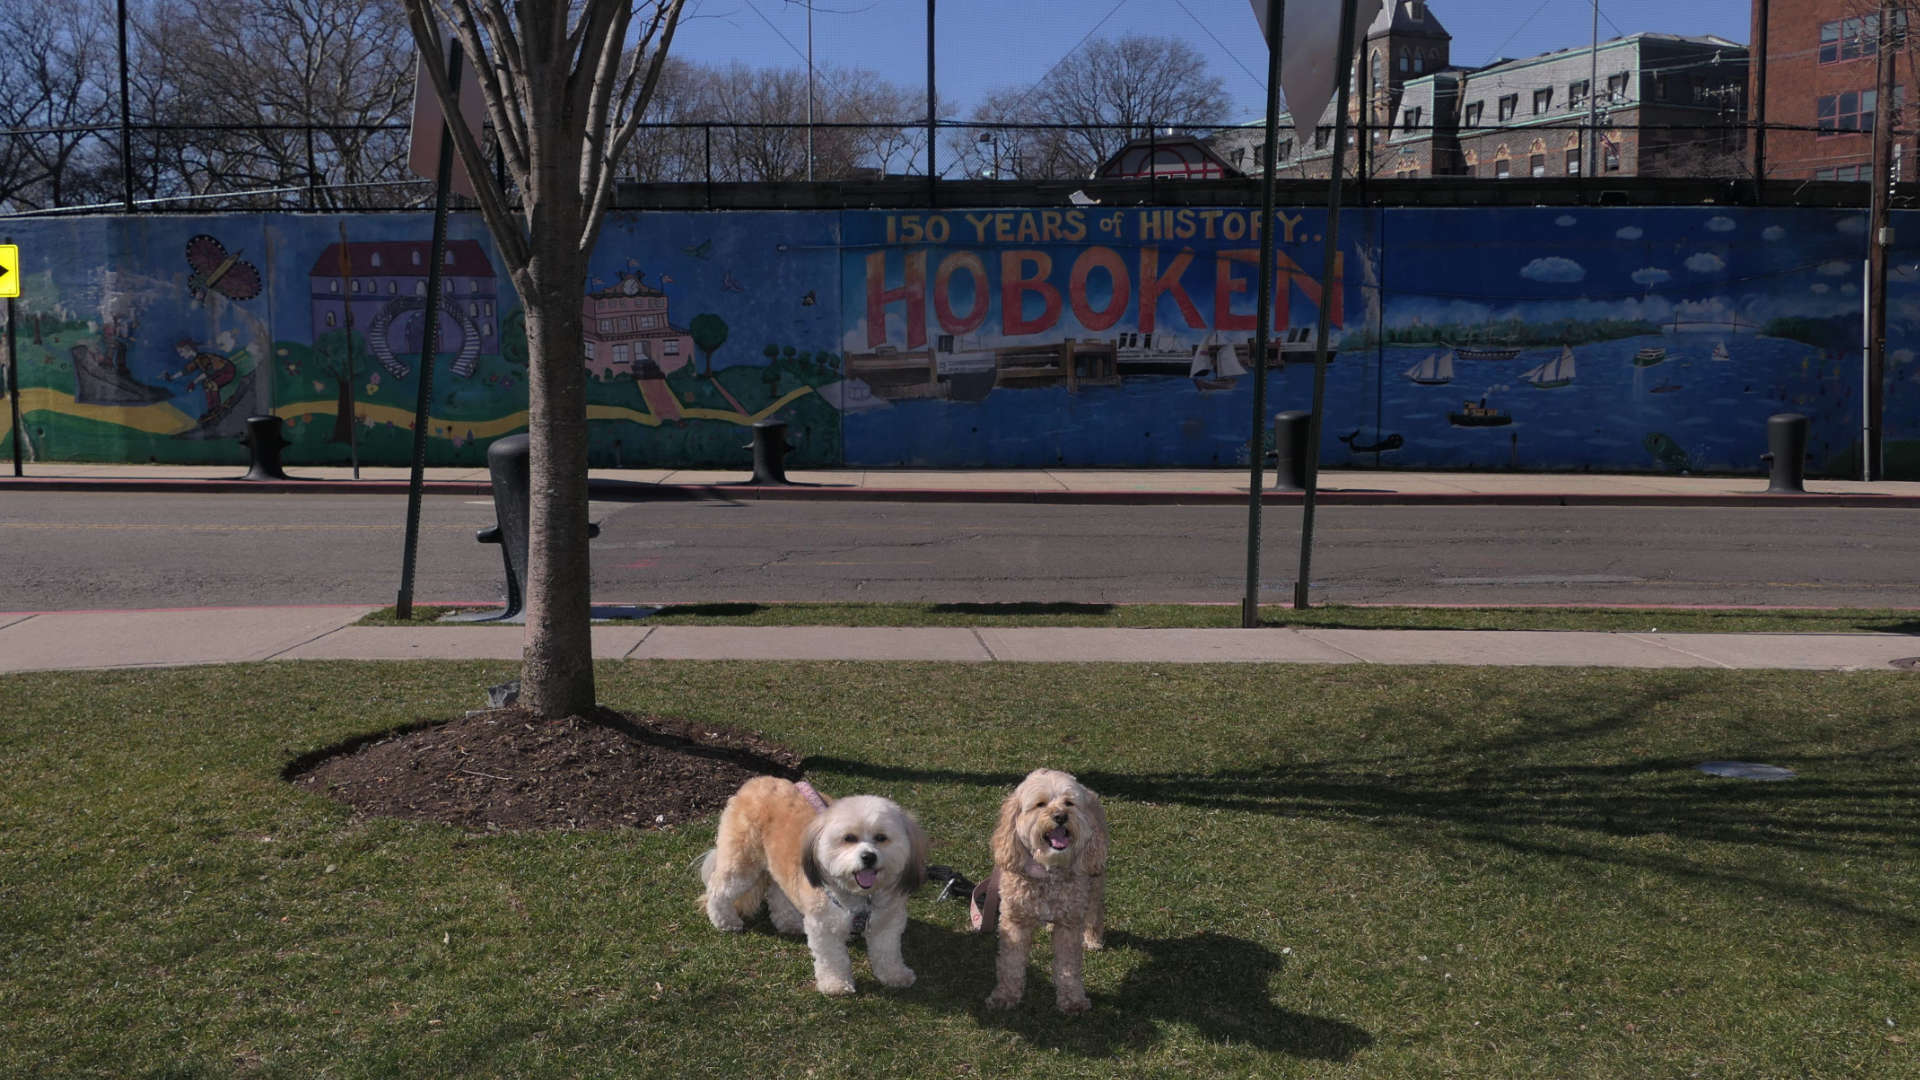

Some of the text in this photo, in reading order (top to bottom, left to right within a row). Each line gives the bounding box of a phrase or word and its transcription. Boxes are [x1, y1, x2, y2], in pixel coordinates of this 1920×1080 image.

[886, 215, 951, 243] 150
[966, 211, 1087, 242] YEARS
[1099, 211, 1126, 238] of
[867, 246, 1344, 348] HOBOKEN
